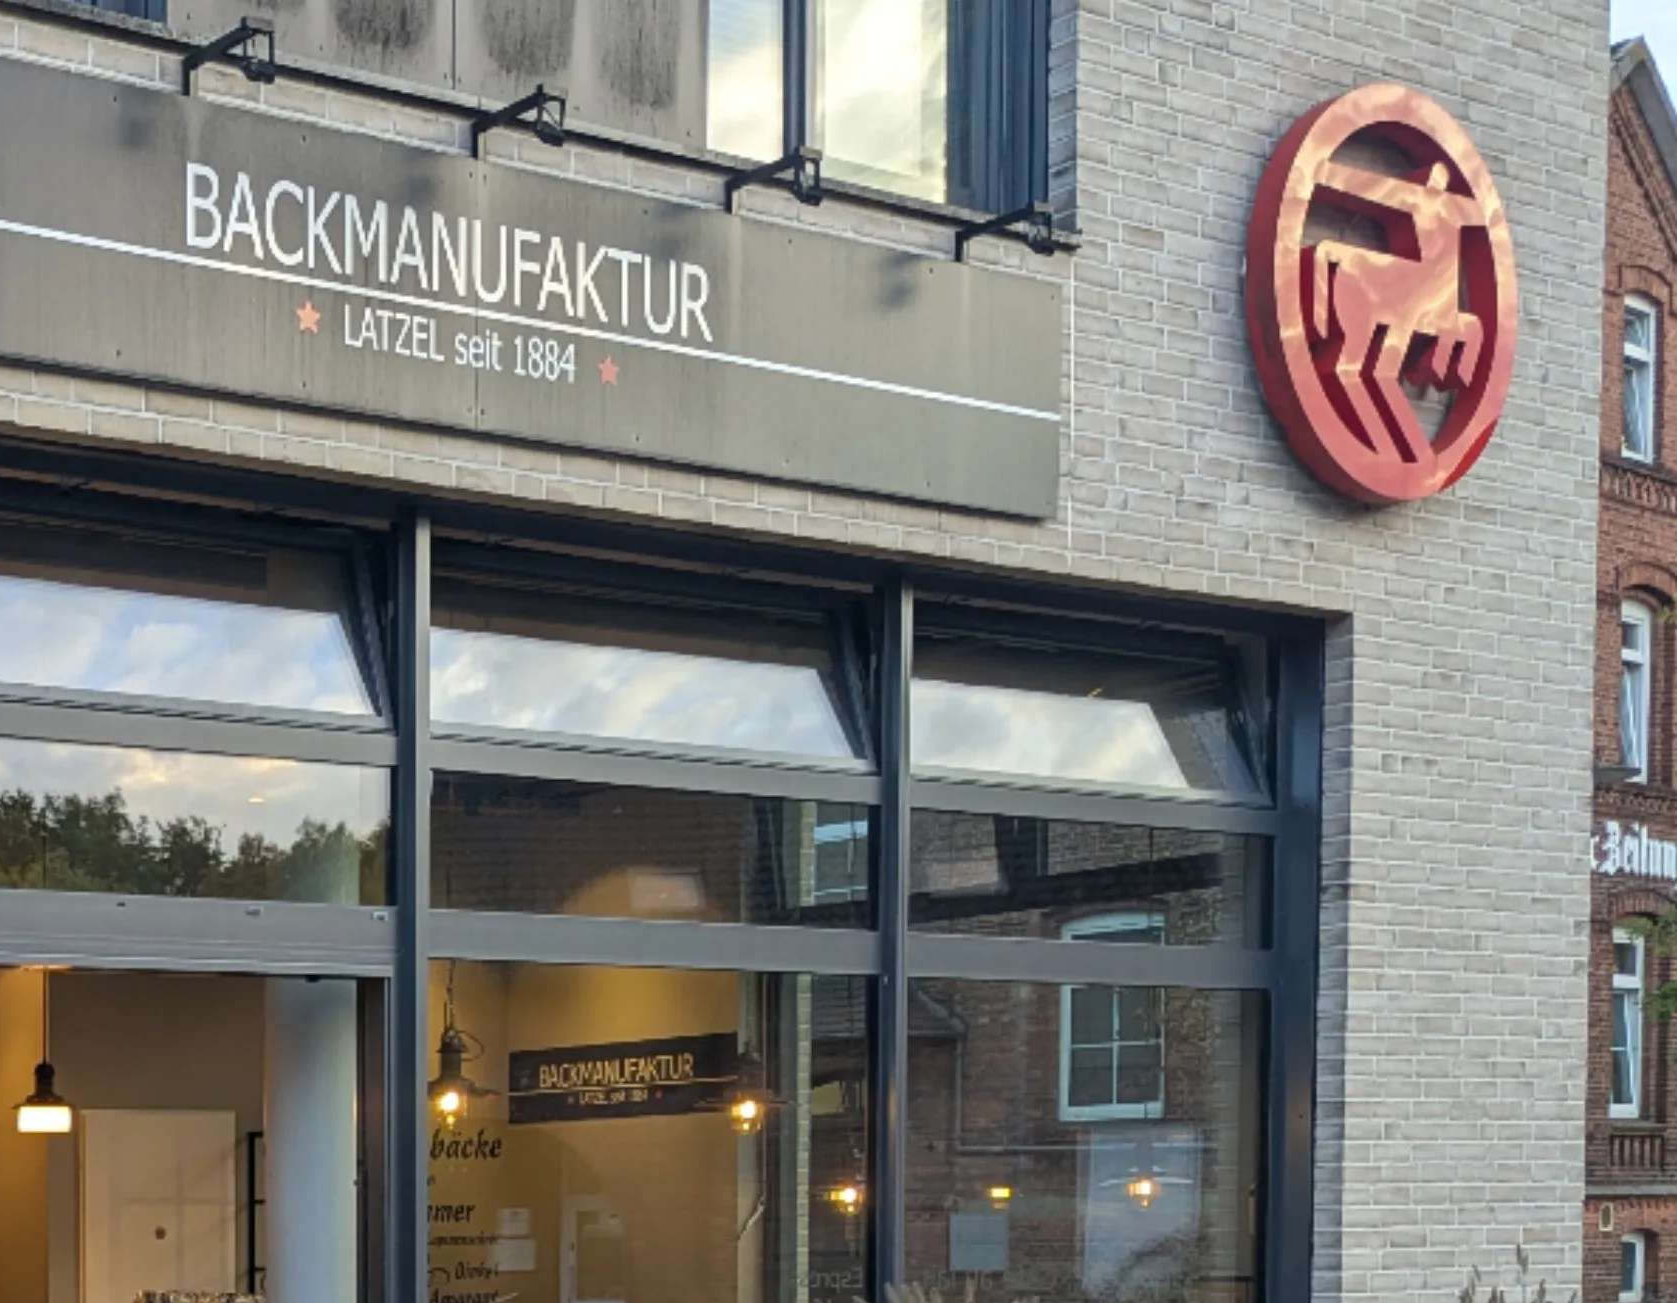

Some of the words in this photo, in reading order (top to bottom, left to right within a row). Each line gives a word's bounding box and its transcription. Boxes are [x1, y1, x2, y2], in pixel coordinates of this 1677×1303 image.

[186, 160, 713, 343] BACKMANUFAKTUR
[344, 304, 445, 362] LATZEL
[454, 329, 504, 372] seit
[513, 334, 577, 384] 1884
[539, 1052, 694, 1088] BACKMANUFAKTUR
